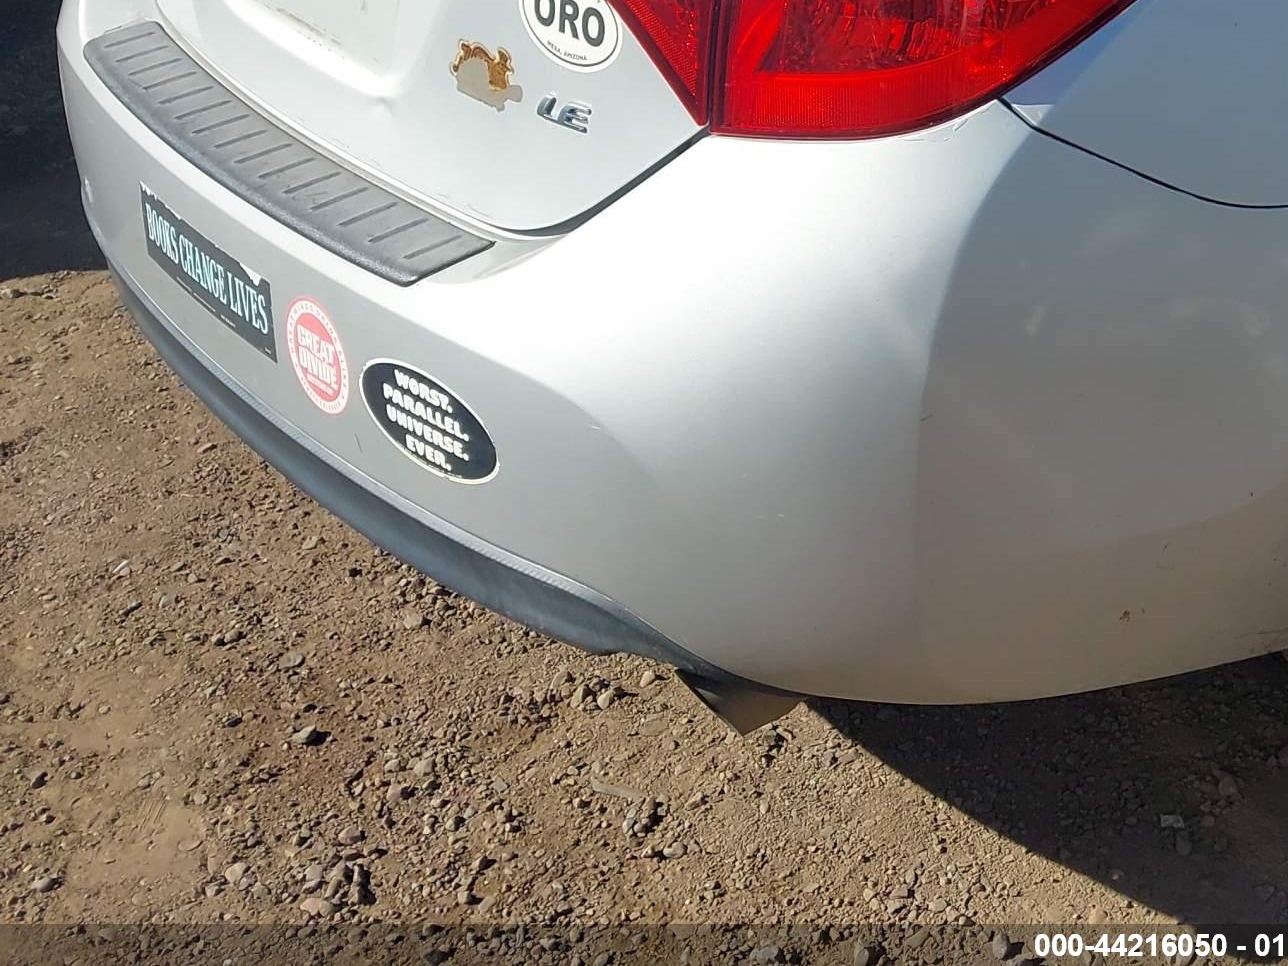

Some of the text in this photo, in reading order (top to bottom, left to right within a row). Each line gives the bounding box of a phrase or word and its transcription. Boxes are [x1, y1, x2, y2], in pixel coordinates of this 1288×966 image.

[536, 95, 592, 134] LE
[145, 202, 179, 265] BOOKS
[178, 233, 228, 306] CHANGE
[227, 270, 269, 335] LIVES
[297, 323, 335, 364] GREAT
[298, 344, 338, 392] DIVIDE
[383, 382, 470, 443] PARALLEL.
[394, 369, 453, 414] WORST.
[386, 404, 470, 462] UNIVERSE.
[405, 434, 452, 472] EVER.
